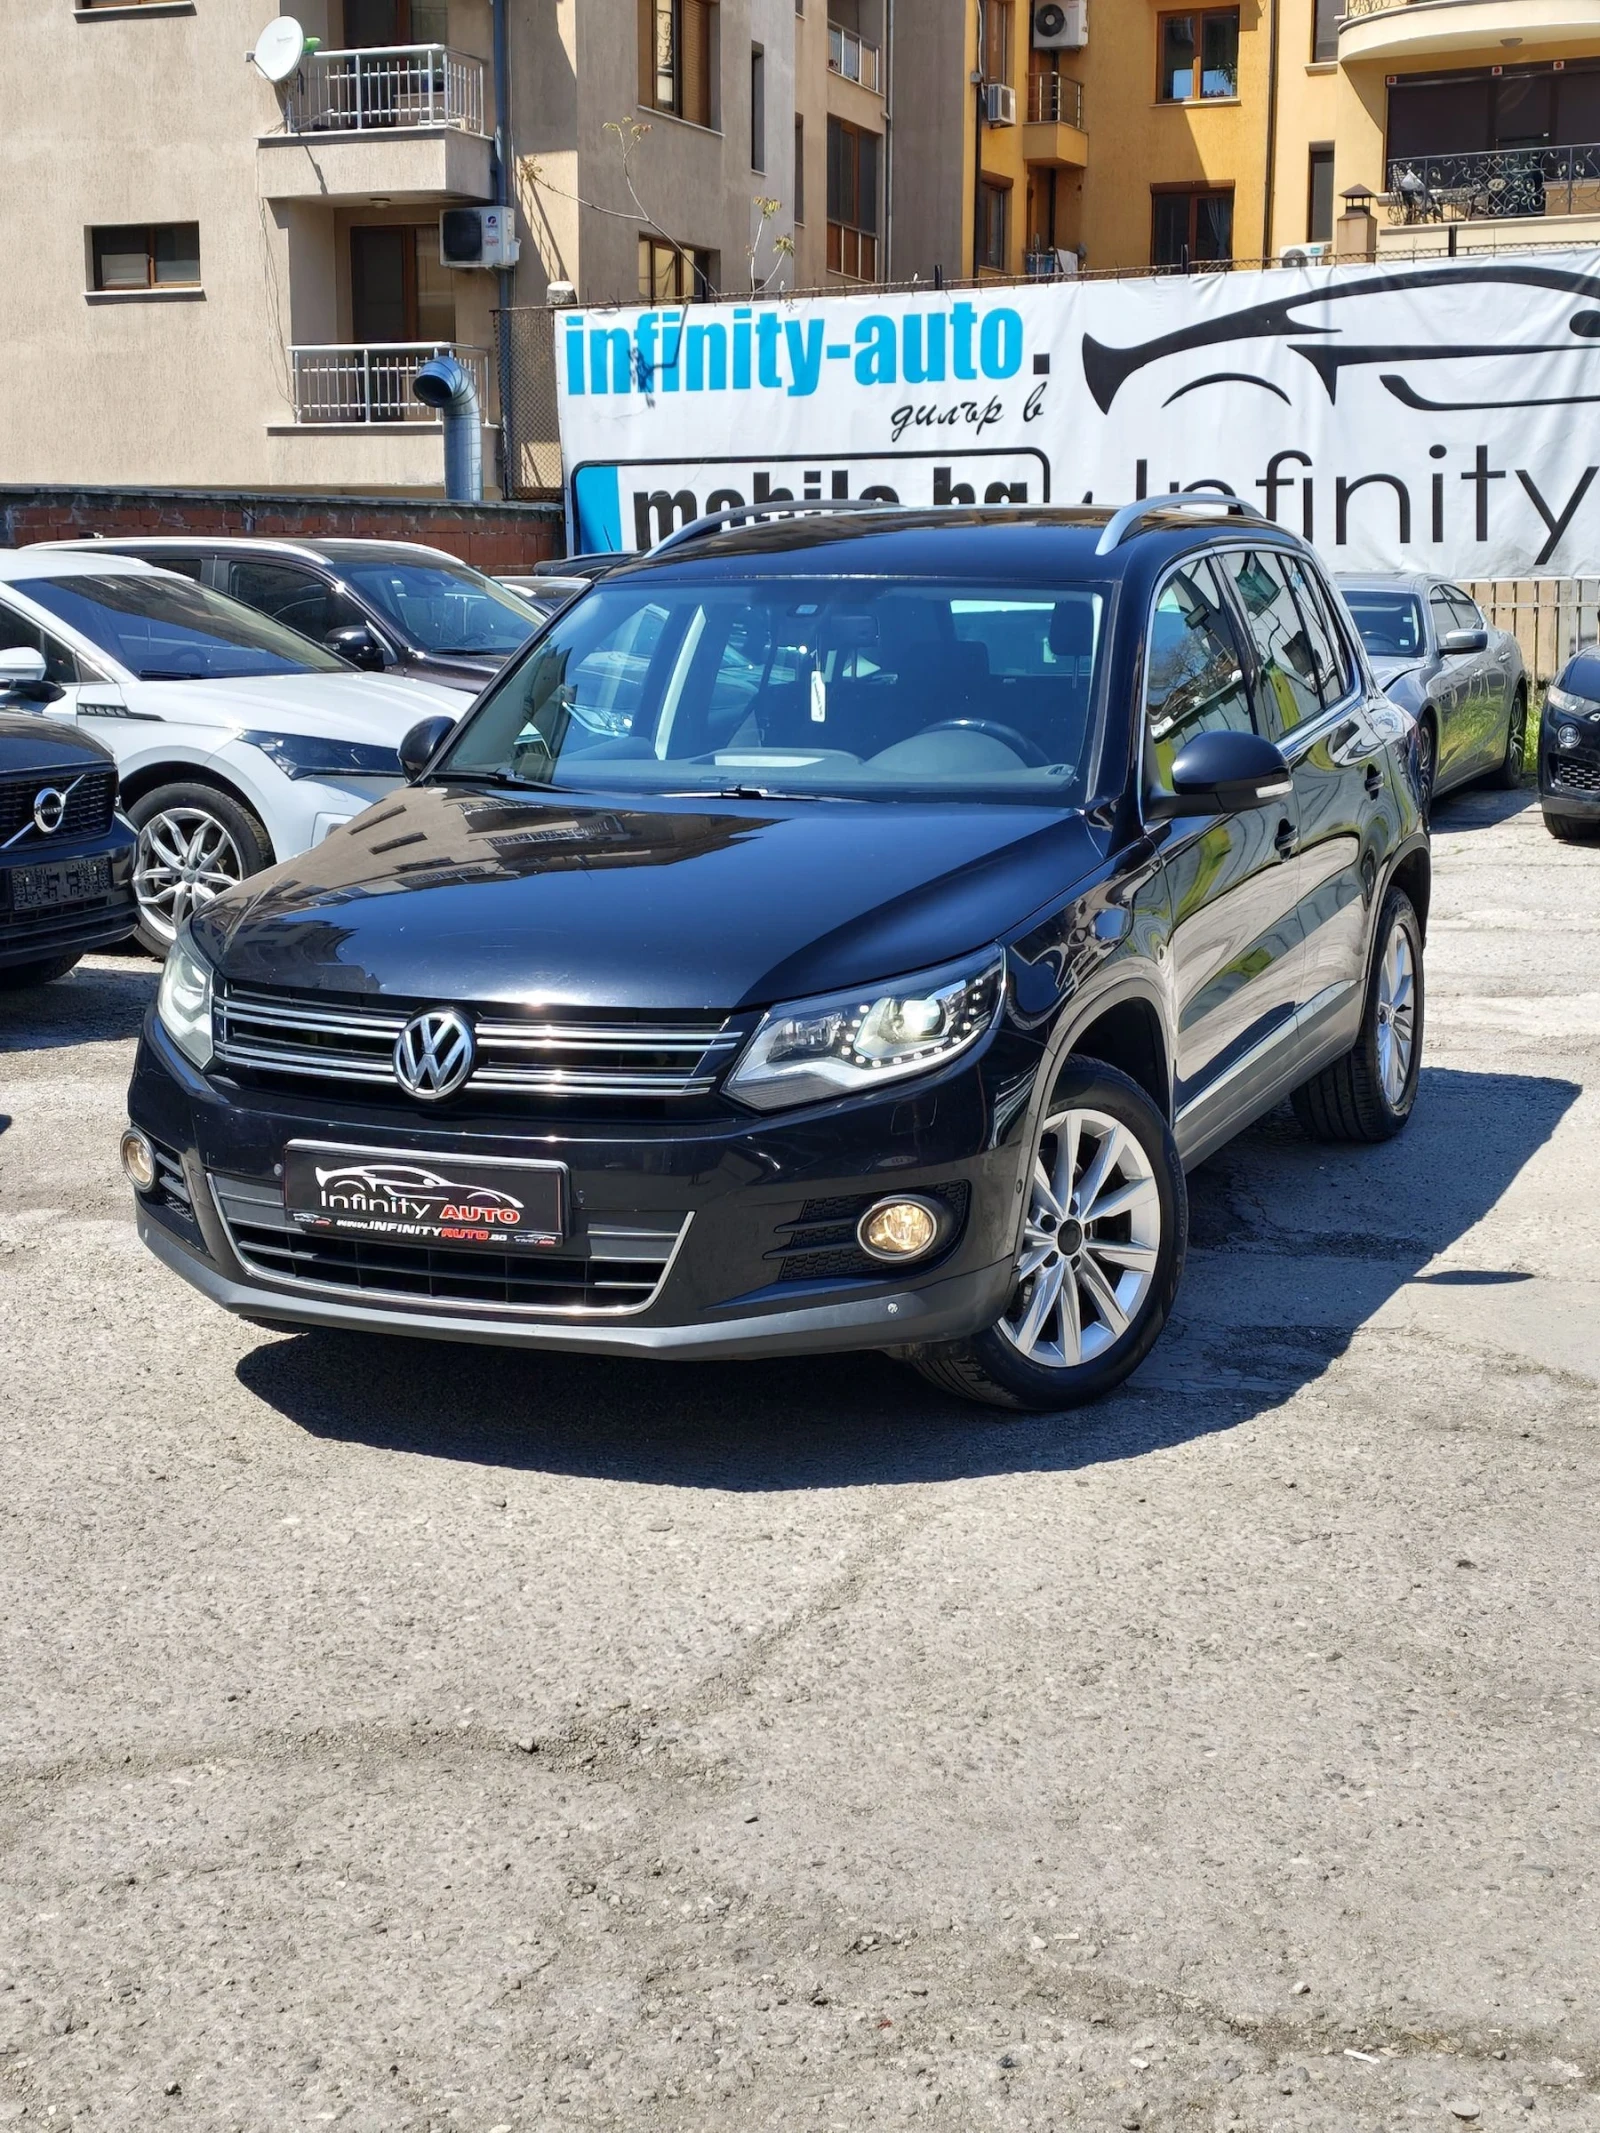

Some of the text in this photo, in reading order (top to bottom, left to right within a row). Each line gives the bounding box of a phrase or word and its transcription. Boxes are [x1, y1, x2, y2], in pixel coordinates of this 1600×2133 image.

[890, 394, 1004, 443] дилър
[1135, 444, 1599, 566] finity
[320, 1190, 521, 1224] Infinity AUTO
